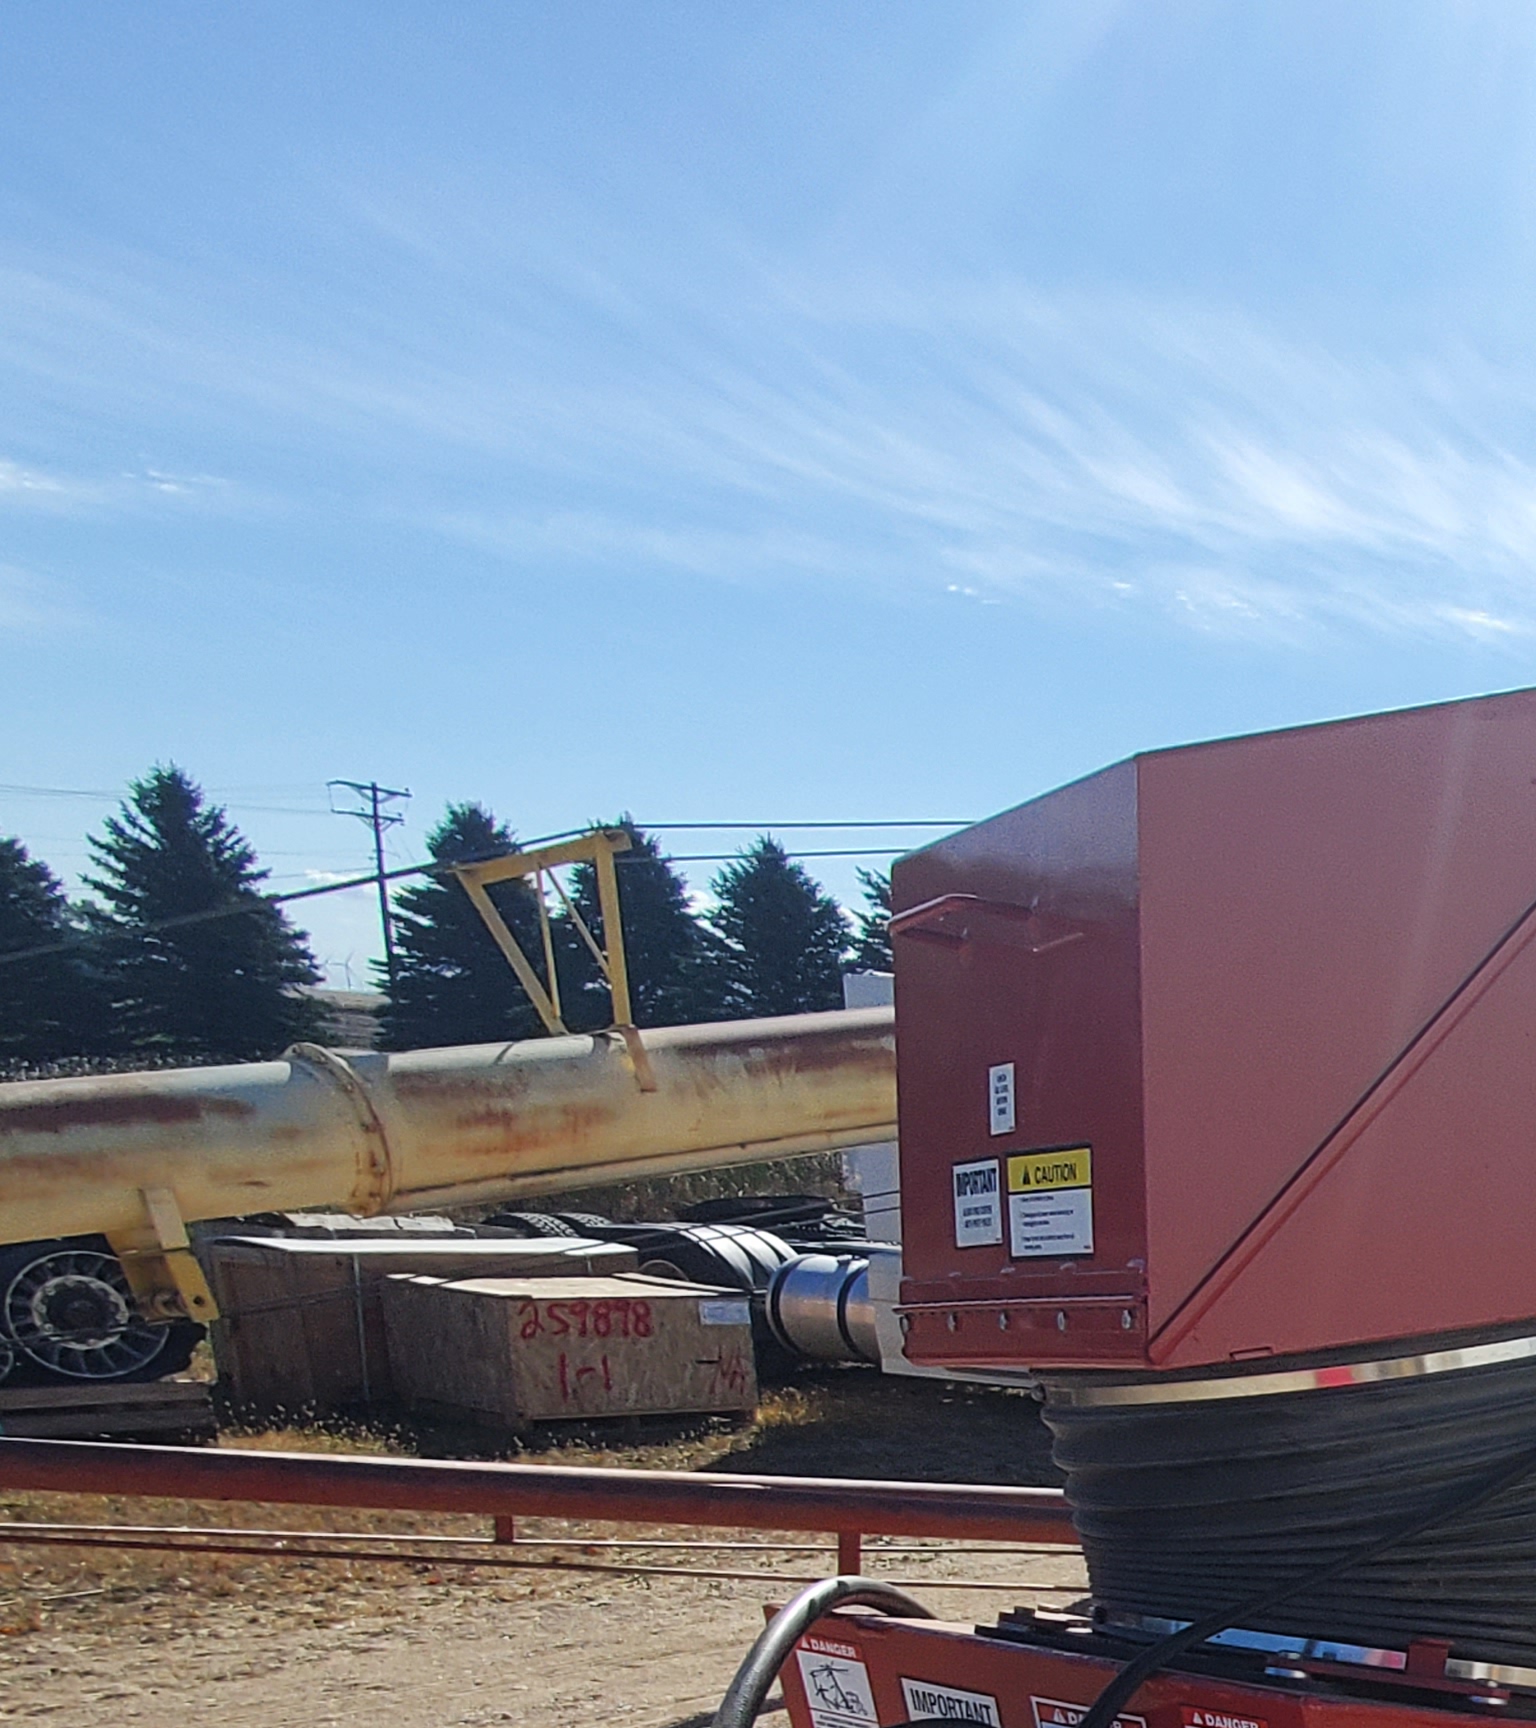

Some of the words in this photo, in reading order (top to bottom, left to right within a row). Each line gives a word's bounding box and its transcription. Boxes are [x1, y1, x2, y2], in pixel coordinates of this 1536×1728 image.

[956, 1168, 997, 1197] IMPORTANT
[1034, 1163, 1077, 1185] CAUTION
[518, 1299, 654, 1340] 259898
[810, 1638, 857, 1659] DANGER
[909, 1687, 992, 1726] IMPORTANT
